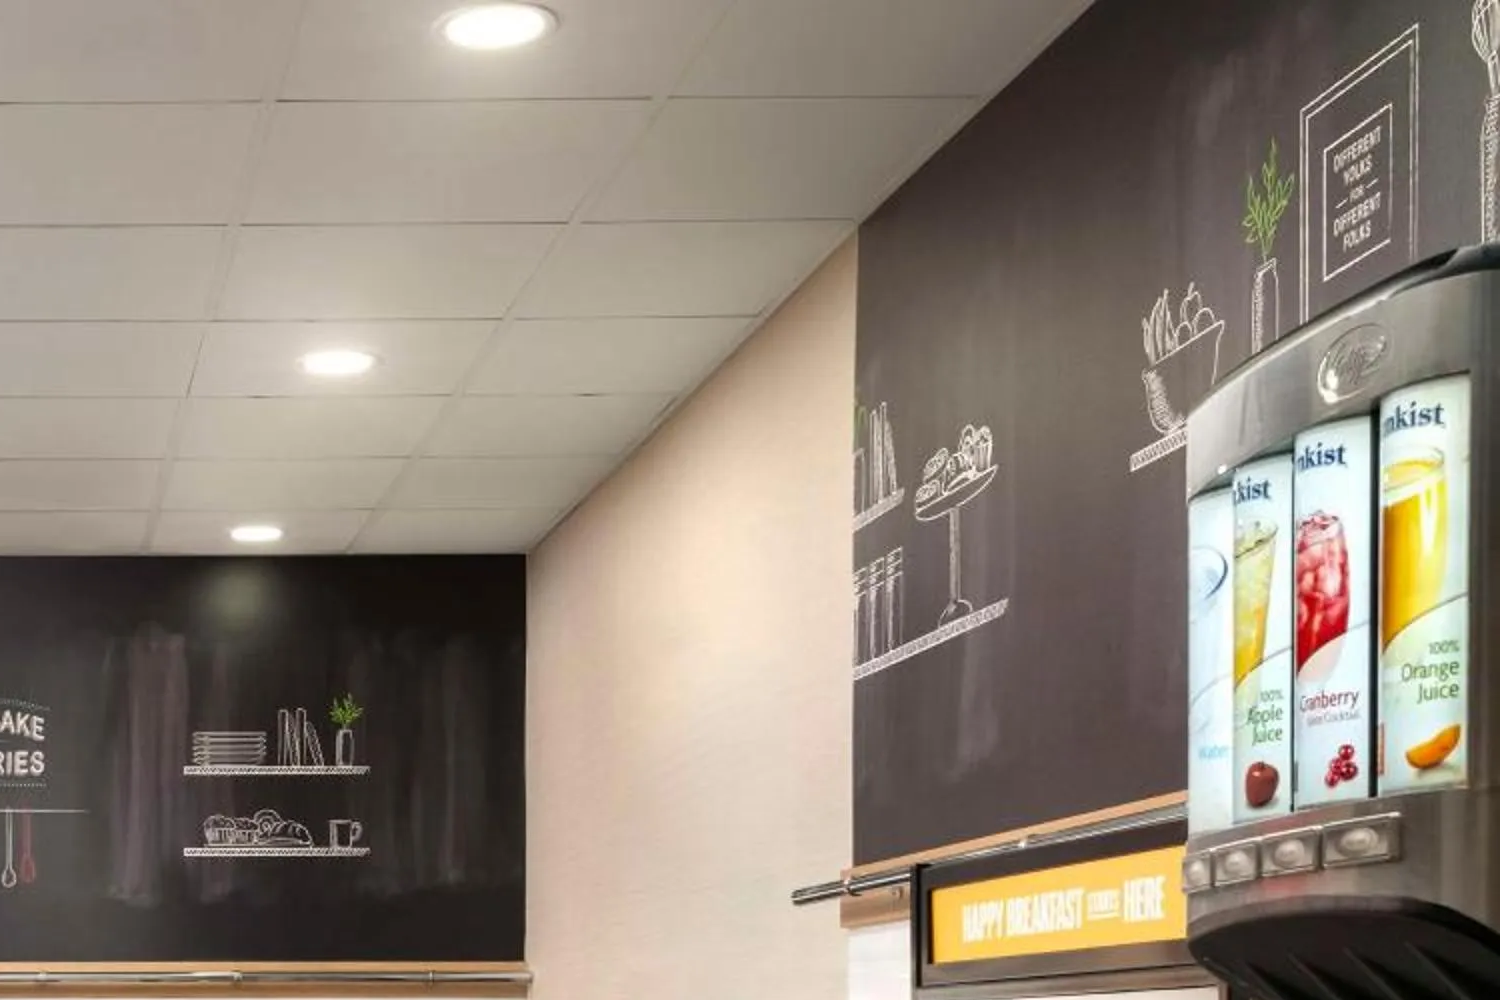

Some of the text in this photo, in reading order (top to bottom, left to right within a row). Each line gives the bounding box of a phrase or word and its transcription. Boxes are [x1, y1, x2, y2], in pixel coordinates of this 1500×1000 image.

[1333, 125, 1381, 174] DIFFERENT
[1343, 153, 1372, 186] YOLKS
[1333, 191, 1381, 237] DIFFERENT
[1343, 219, 1371, 252] FOLKS
[1382, 401, 1445, 434] nkist
[1297, 442, 1347, 471] nkist
[1234, 476, 1271, 505] kist
[1401, 661, 1460, 682] Orange
[1299, 690, 1360, 713] Cranberry
[1417, 683, 1460, 704] Juice
[1246, 704, 1284, 725] Apple
[962, 899, 1005, 943] HAPPY
[1006, 887, 1085, 937] BREAKFAST
[1124, 875, 1167, 923] HERE
